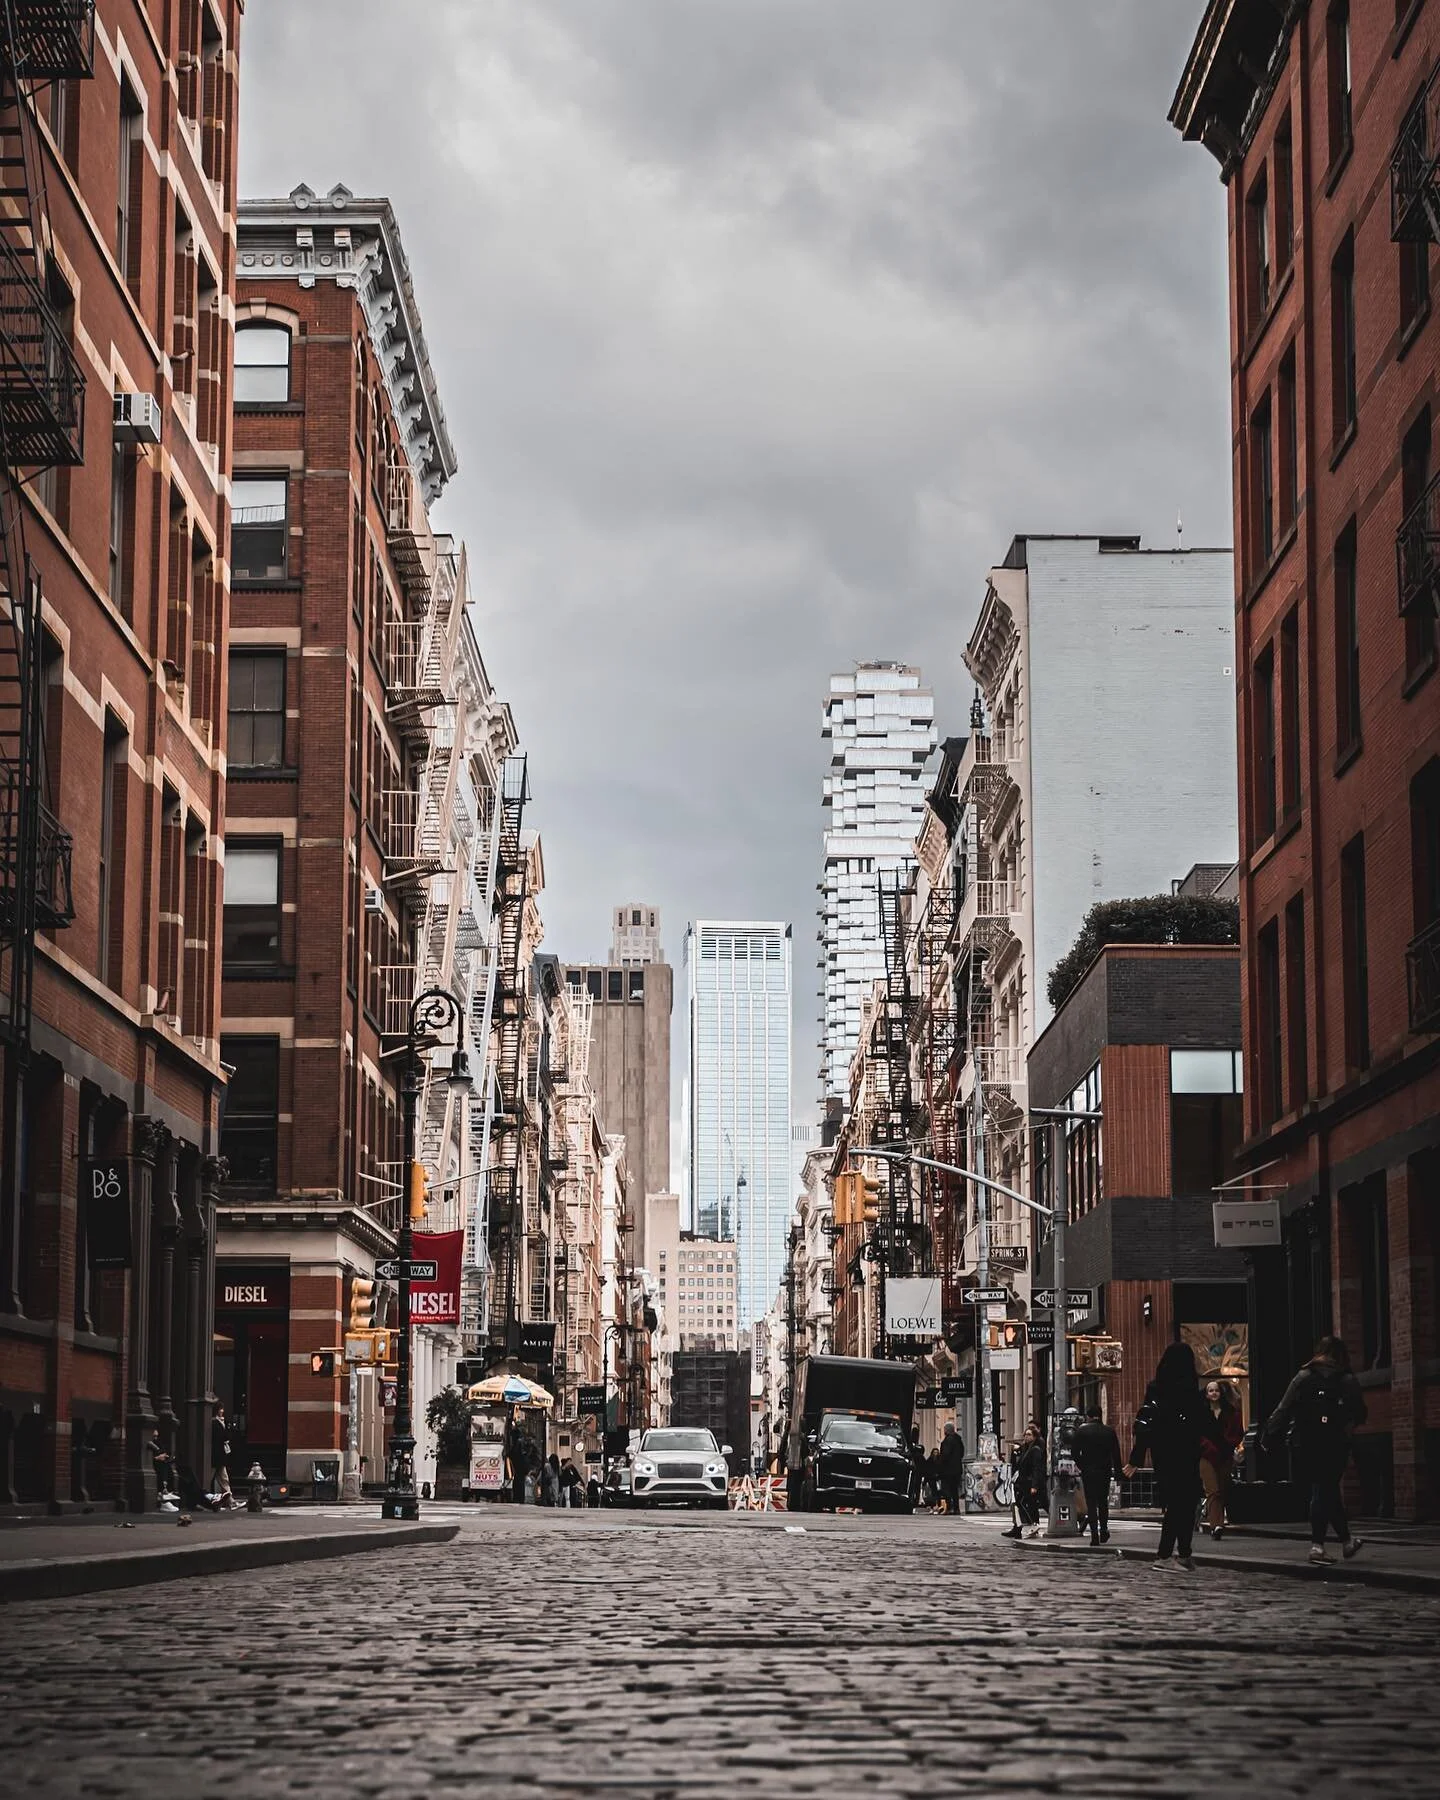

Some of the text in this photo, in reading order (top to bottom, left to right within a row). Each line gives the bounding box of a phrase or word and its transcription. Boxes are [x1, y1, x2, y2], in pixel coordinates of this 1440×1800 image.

[990, 1248, 1026, 1257] SPRING ST
[411, 1265, 432, 1275] WAY
[224, 1286, 268, 1302] DIESEL
[409, 1292, 456, 1315] IESEL
[891, 1317, 936, 1329] LOEWE
[523, 1339, 552, 1347] AMIRI
[948, 1380, 965, 1389] ami
